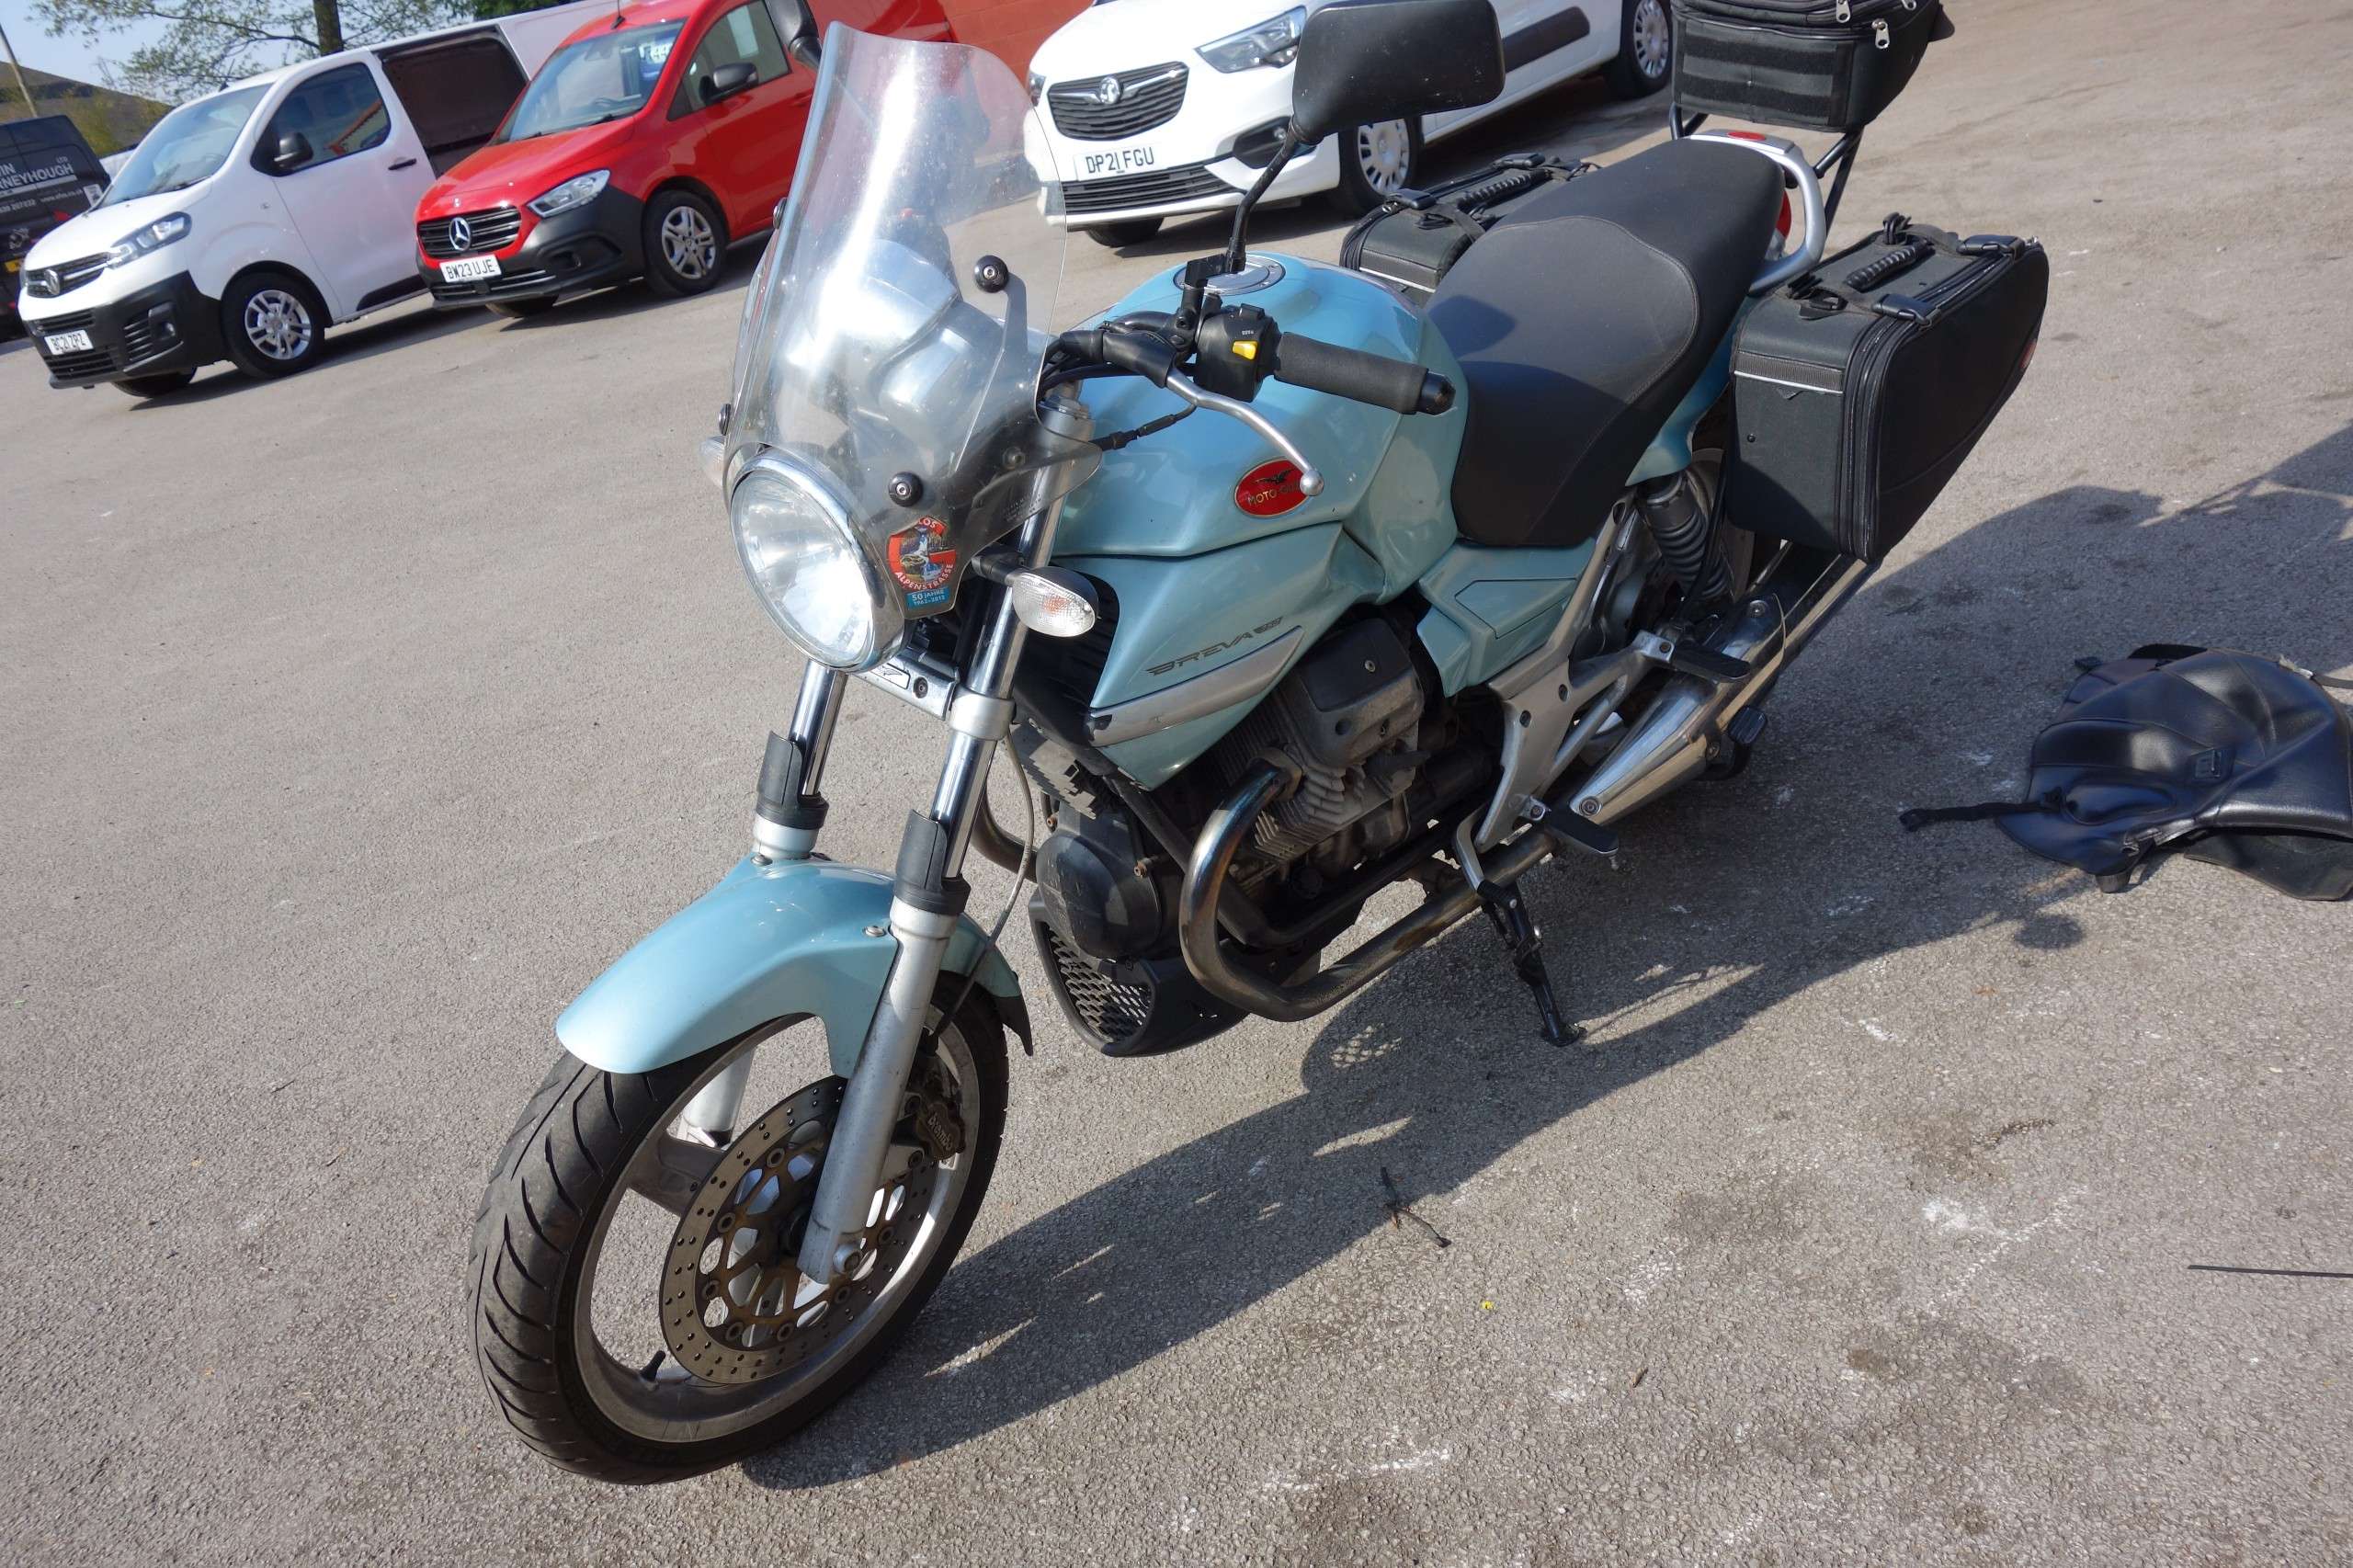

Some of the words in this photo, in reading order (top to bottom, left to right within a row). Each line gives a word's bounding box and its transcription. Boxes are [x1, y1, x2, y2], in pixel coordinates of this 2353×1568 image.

[1086, 152, 1120, 174] DP21
[1122, 147, 1154, 168] FGU
[0, 163, 17, 177] IN
[472, 259, 495, 275] UJE
[1247, 489, 1278, 506] MOTO
[894, 563, 953, 590] ALPENSTRASSE
[912, 593, 924, 602] 50
[1145, 631, 1254, 676] BREVA
